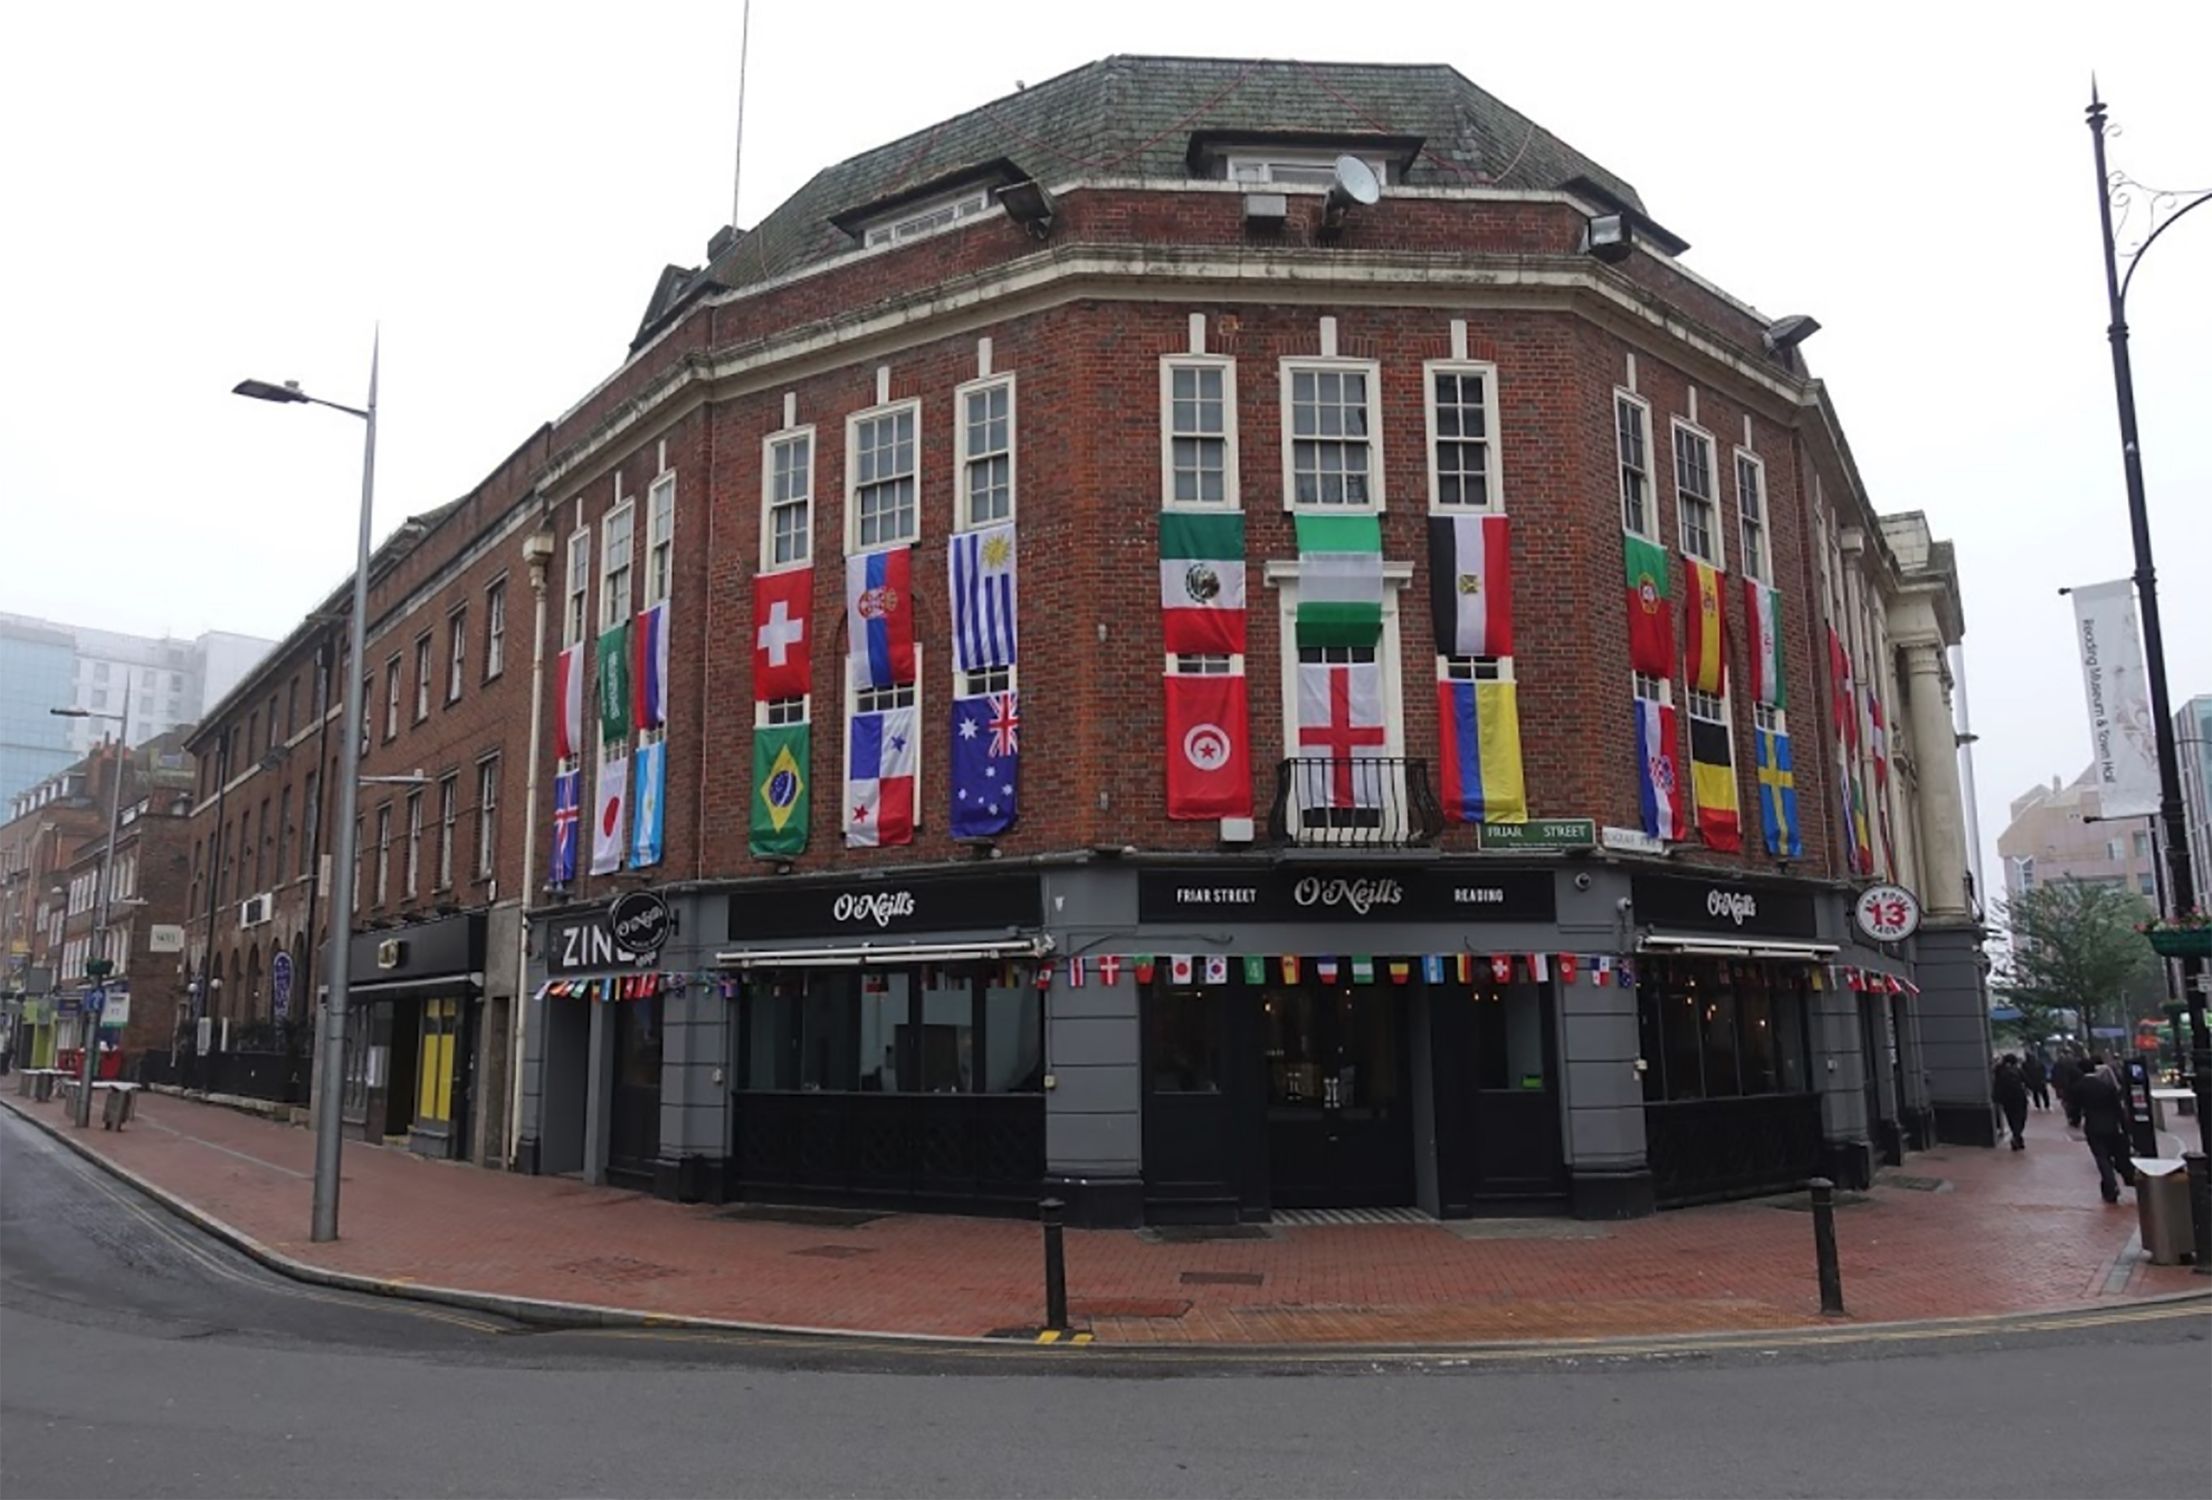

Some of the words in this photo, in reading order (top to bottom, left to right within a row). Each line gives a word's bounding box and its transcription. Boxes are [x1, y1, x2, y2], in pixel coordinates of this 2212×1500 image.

[2083, 619, 2098, 666] Reading
[2089, 667, 2103, 717] Museum
[2099, 729, 2110, 759] Town
[1487, 825, 1524, 838] FRIAR
[1543, 825, 1587, 838] STREET
[833, 891, 915, 927] O'Neill's
[1176, 888, 1211, 903] FRIAR
[1213, 888, 1257, 903] STREET
[1294, 876, 1403, 914] O'Neill's
[1453, 888, 1504, 903] READING
[1871, 902, 1906, 926] 13
